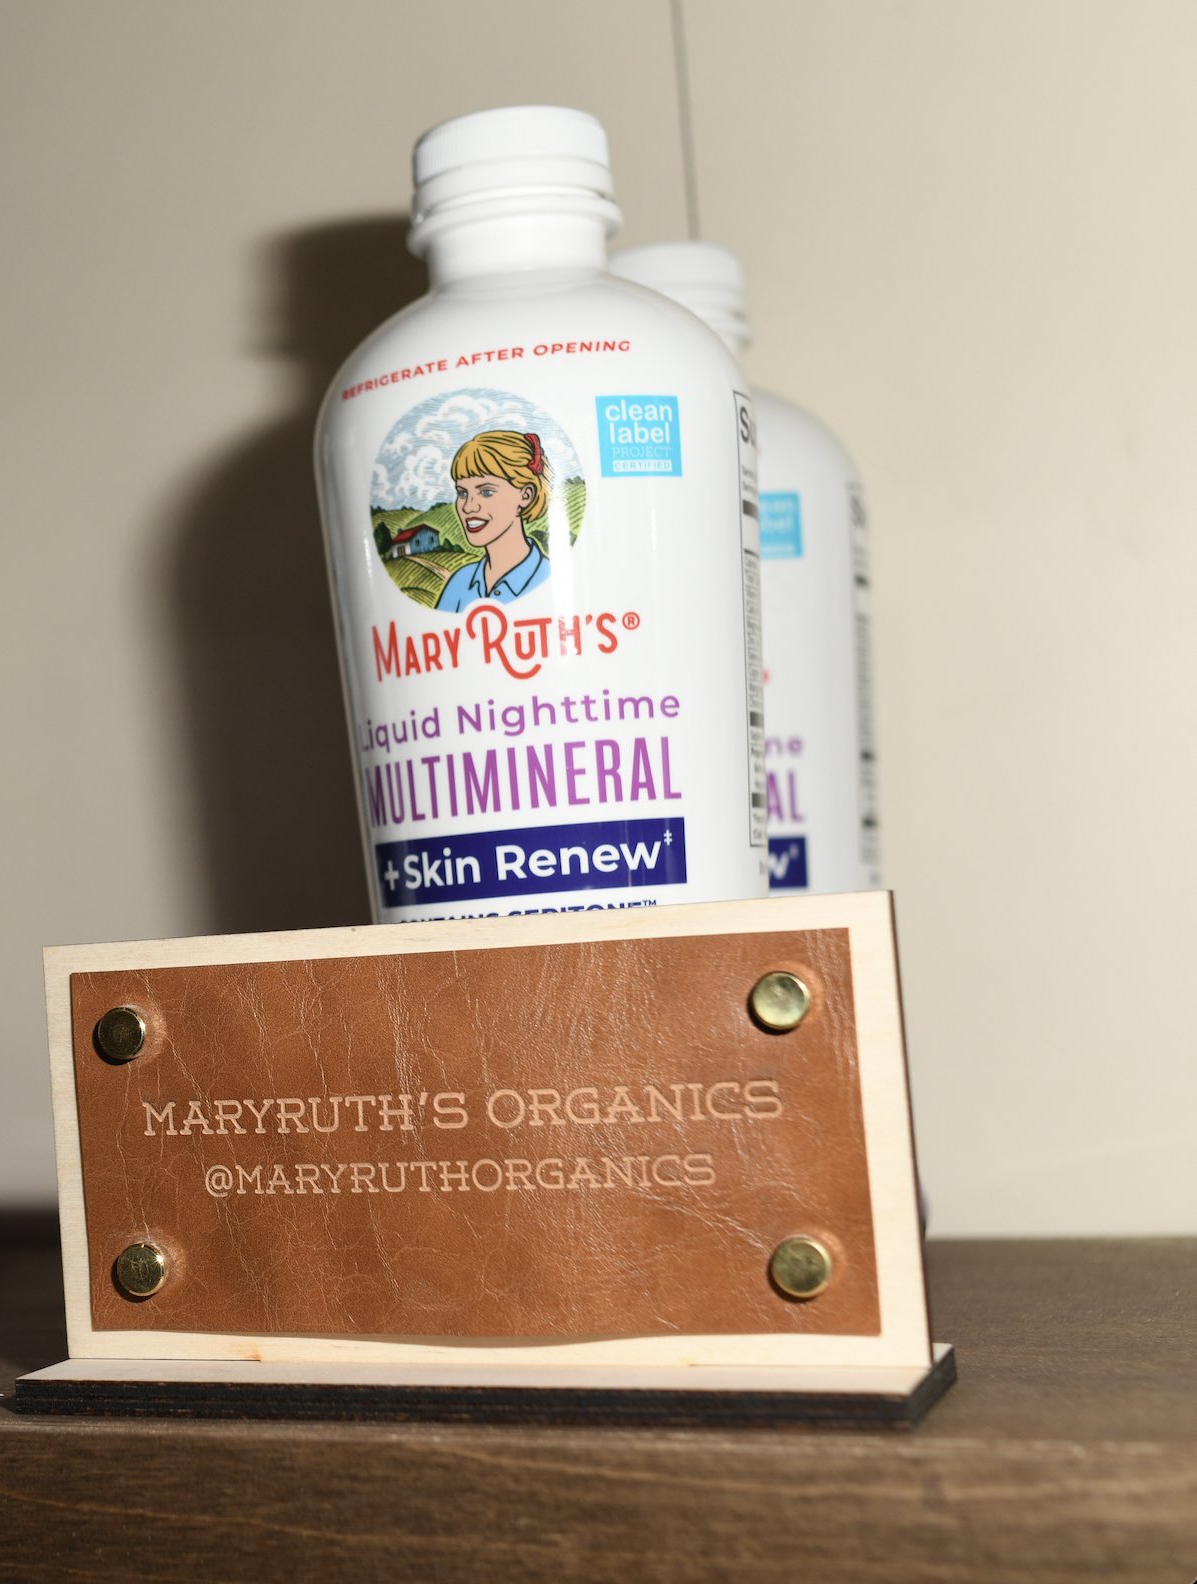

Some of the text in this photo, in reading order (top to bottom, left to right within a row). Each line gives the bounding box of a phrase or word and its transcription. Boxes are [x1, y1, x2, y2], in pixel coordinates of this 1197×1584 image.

[456, 347, 525, 369] AFTER
[533, 339, 632, 357] OPENING
[605, 399, 672, 422] clean
[609, 421, 670, 444] label
[612, 445, 672, 458] PROJECT
[456, 688, 681, 738] Nighttime
[365, 735, 683, 829] MULTIMINERAL
[143, 1079, 783, 1137] MARYRUTH'S ORGANICS
[204, 1153, 717, 1199] @MARYRUTHORGANICS
